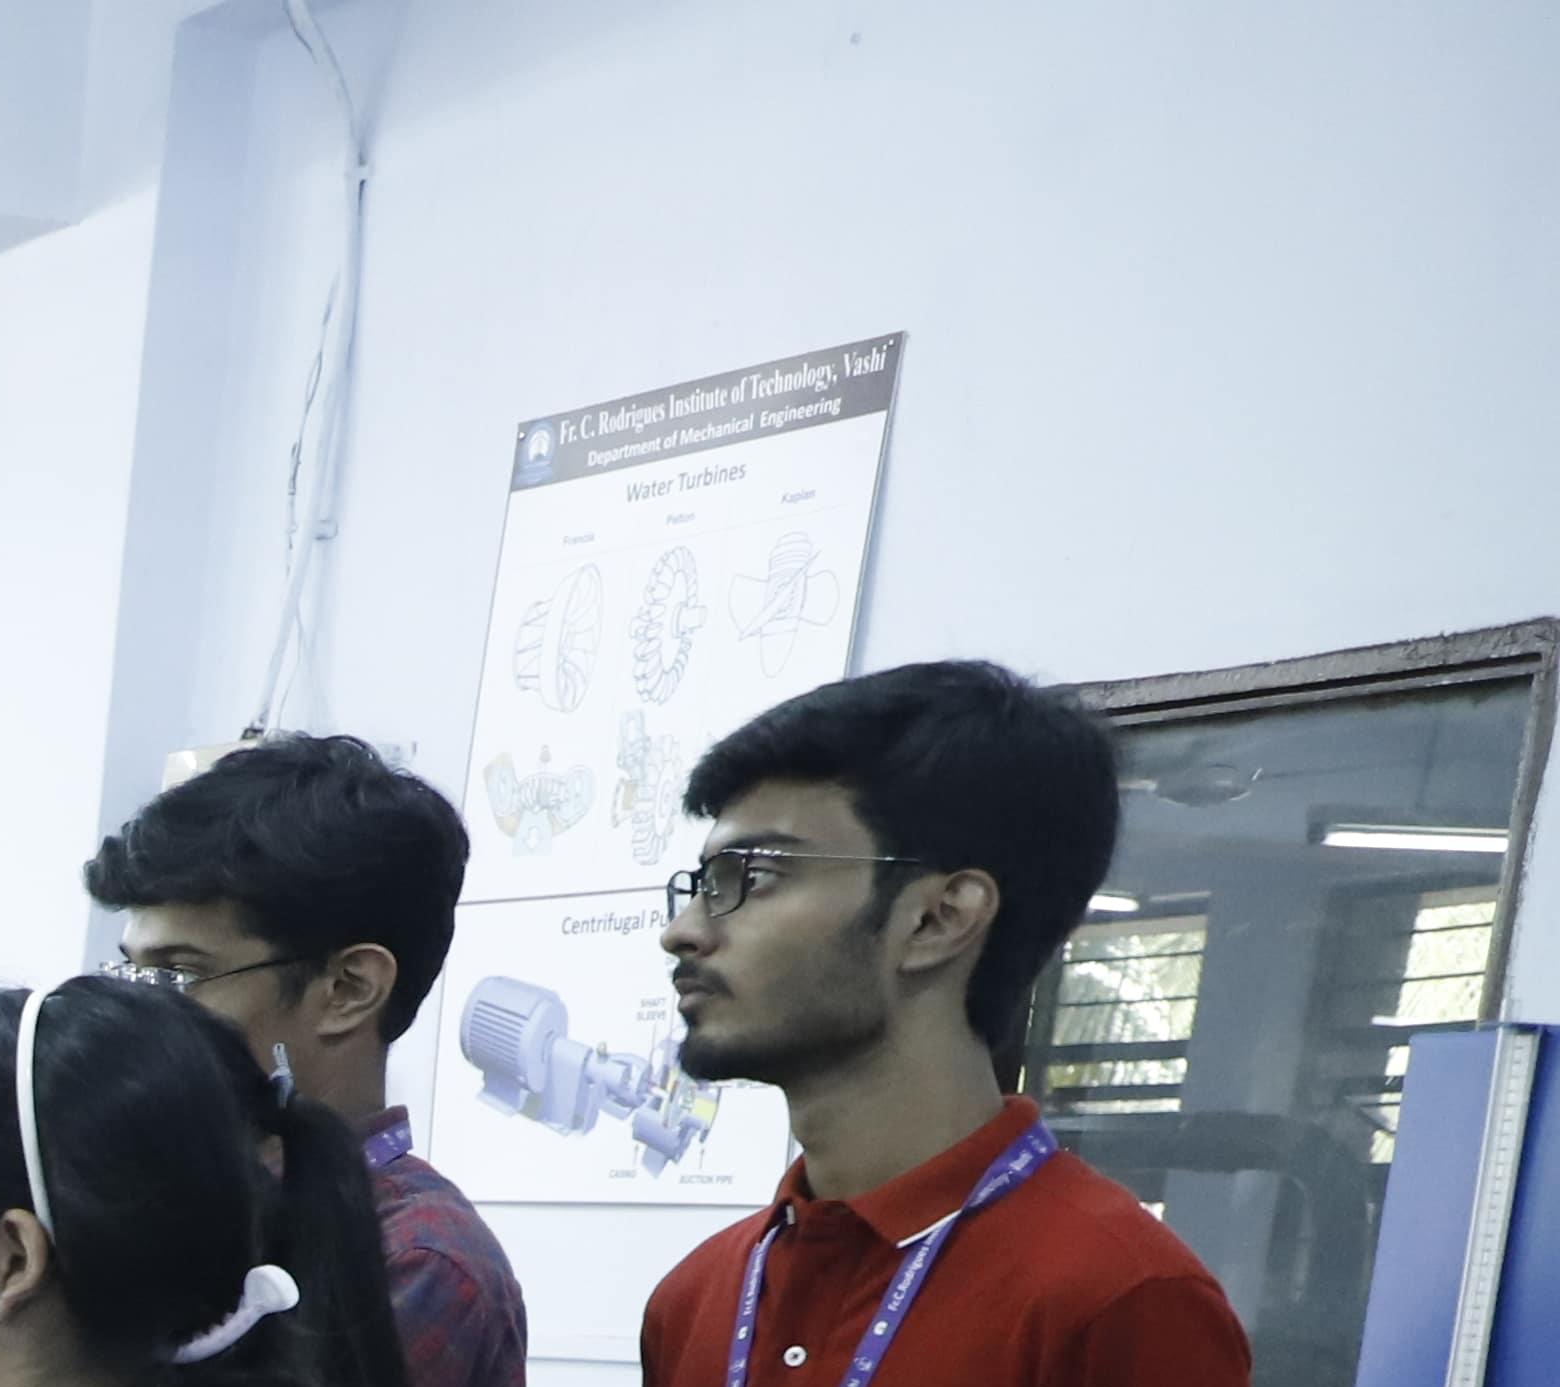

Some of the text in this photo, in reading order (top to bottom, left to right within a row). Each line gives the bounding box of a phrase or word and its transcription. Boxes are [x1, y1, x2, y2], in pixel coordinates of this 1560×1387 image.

[560, 346, 887, 444] Fr. C. Rodrigues Institute of Technology, Vashi
[587, 396, 842, 467] Department of Mechanical Engineering
[626, 462, 747, 503] Water Turbines
[781, 488, 816, 505] Kaplan
[561, 910, 669, 936] Centrifugal Pu
